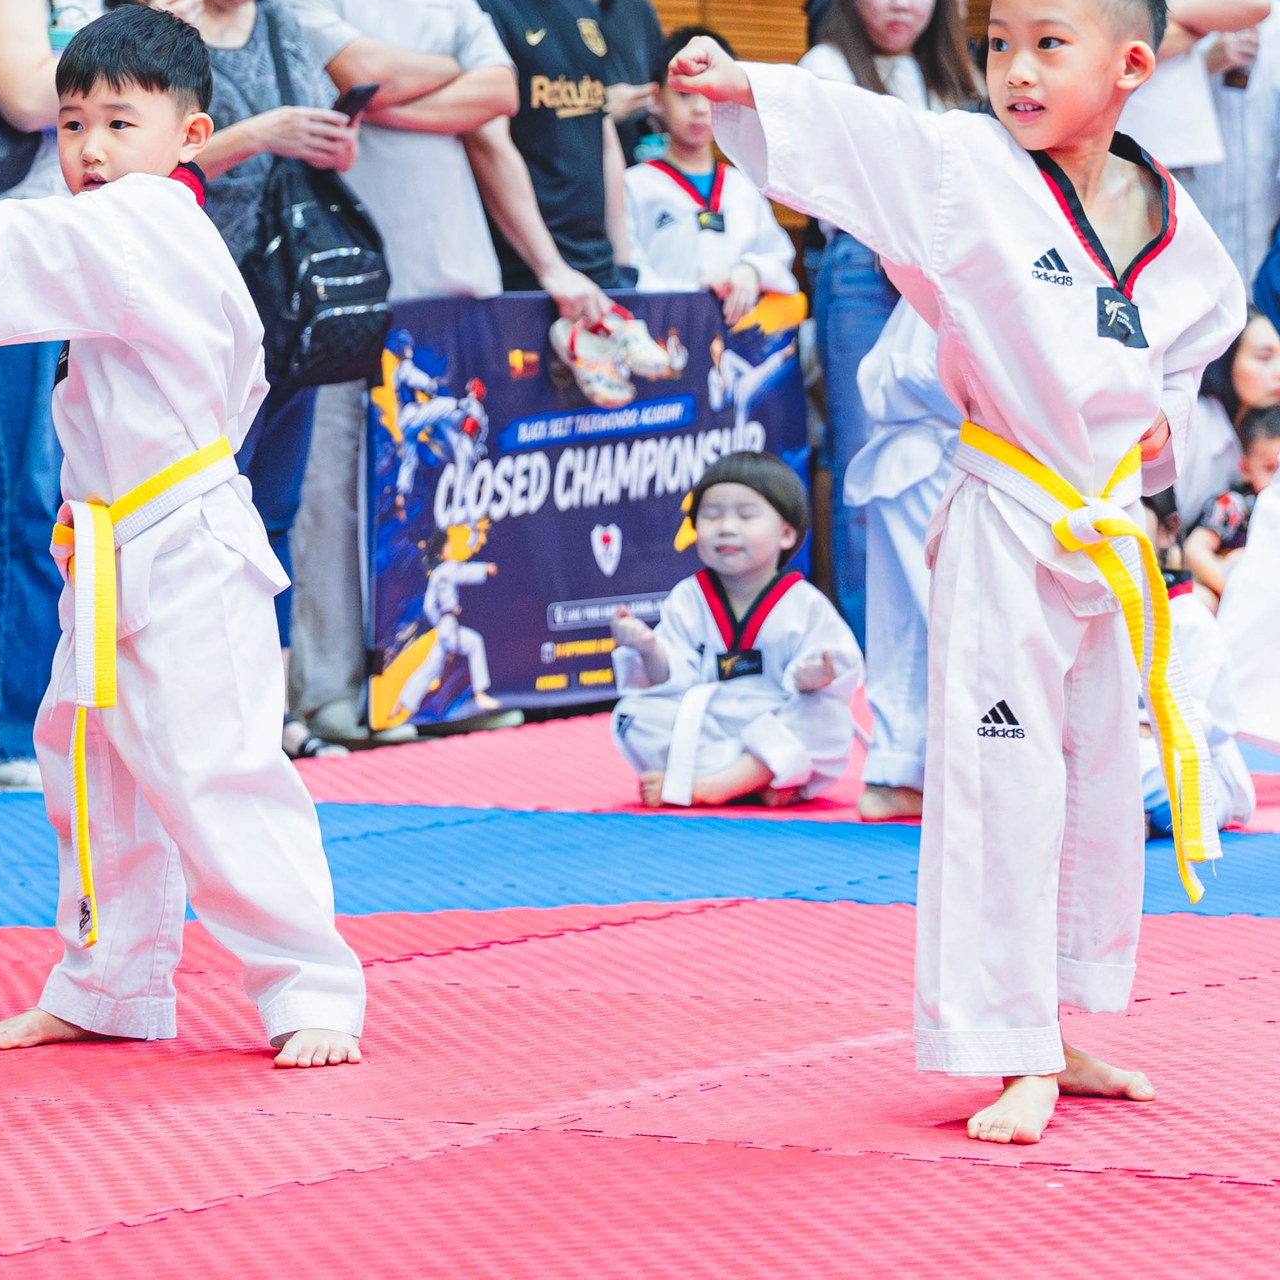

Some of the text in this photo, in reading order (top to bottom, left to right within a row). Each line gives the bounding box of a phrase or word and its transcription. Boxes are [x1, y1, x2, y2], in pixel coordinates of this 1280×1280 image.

[1031, 269, 1073, 287] adidas
[433, 449, 550, 528] CLOSED
[977, 726, 1025, 739] adidas
